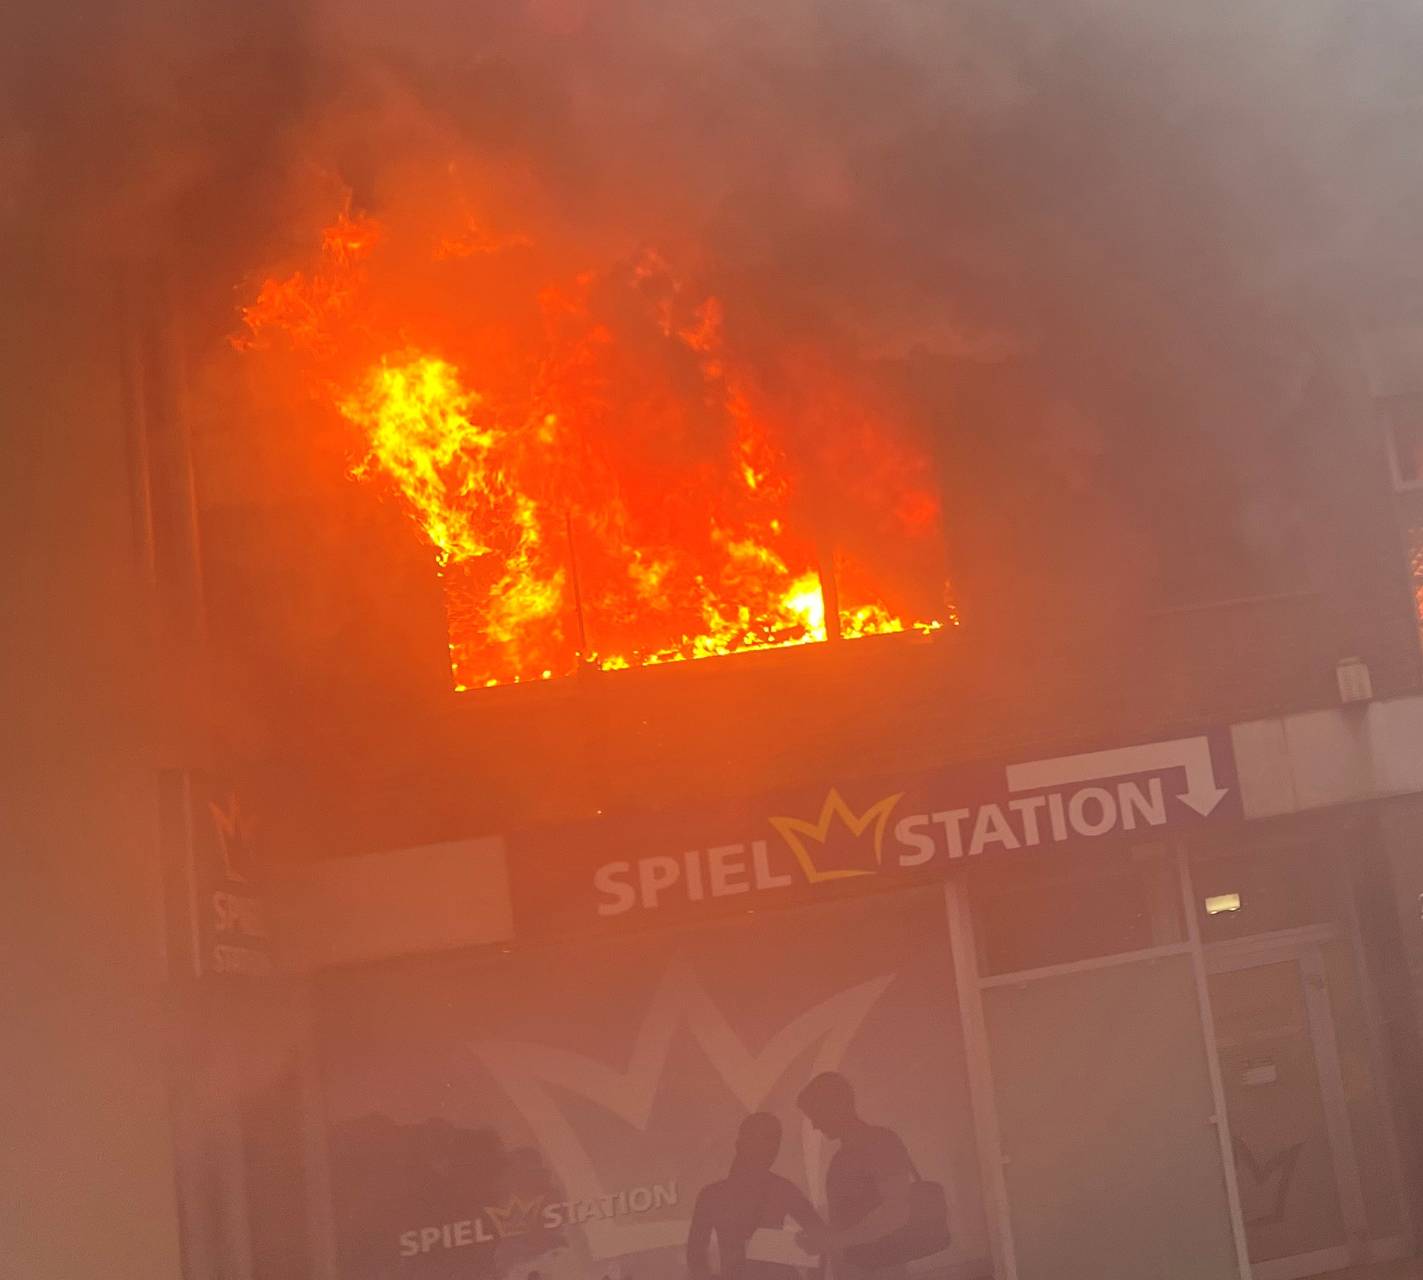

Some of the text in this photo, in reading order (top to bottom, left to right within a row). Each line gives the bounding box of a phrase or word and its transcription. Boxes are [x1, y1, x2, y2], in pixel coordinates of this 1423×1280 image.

[593, 778, 1168, 915] SPIEL STATION
[399, 1180, 680, 1257] SPIEL STATION
